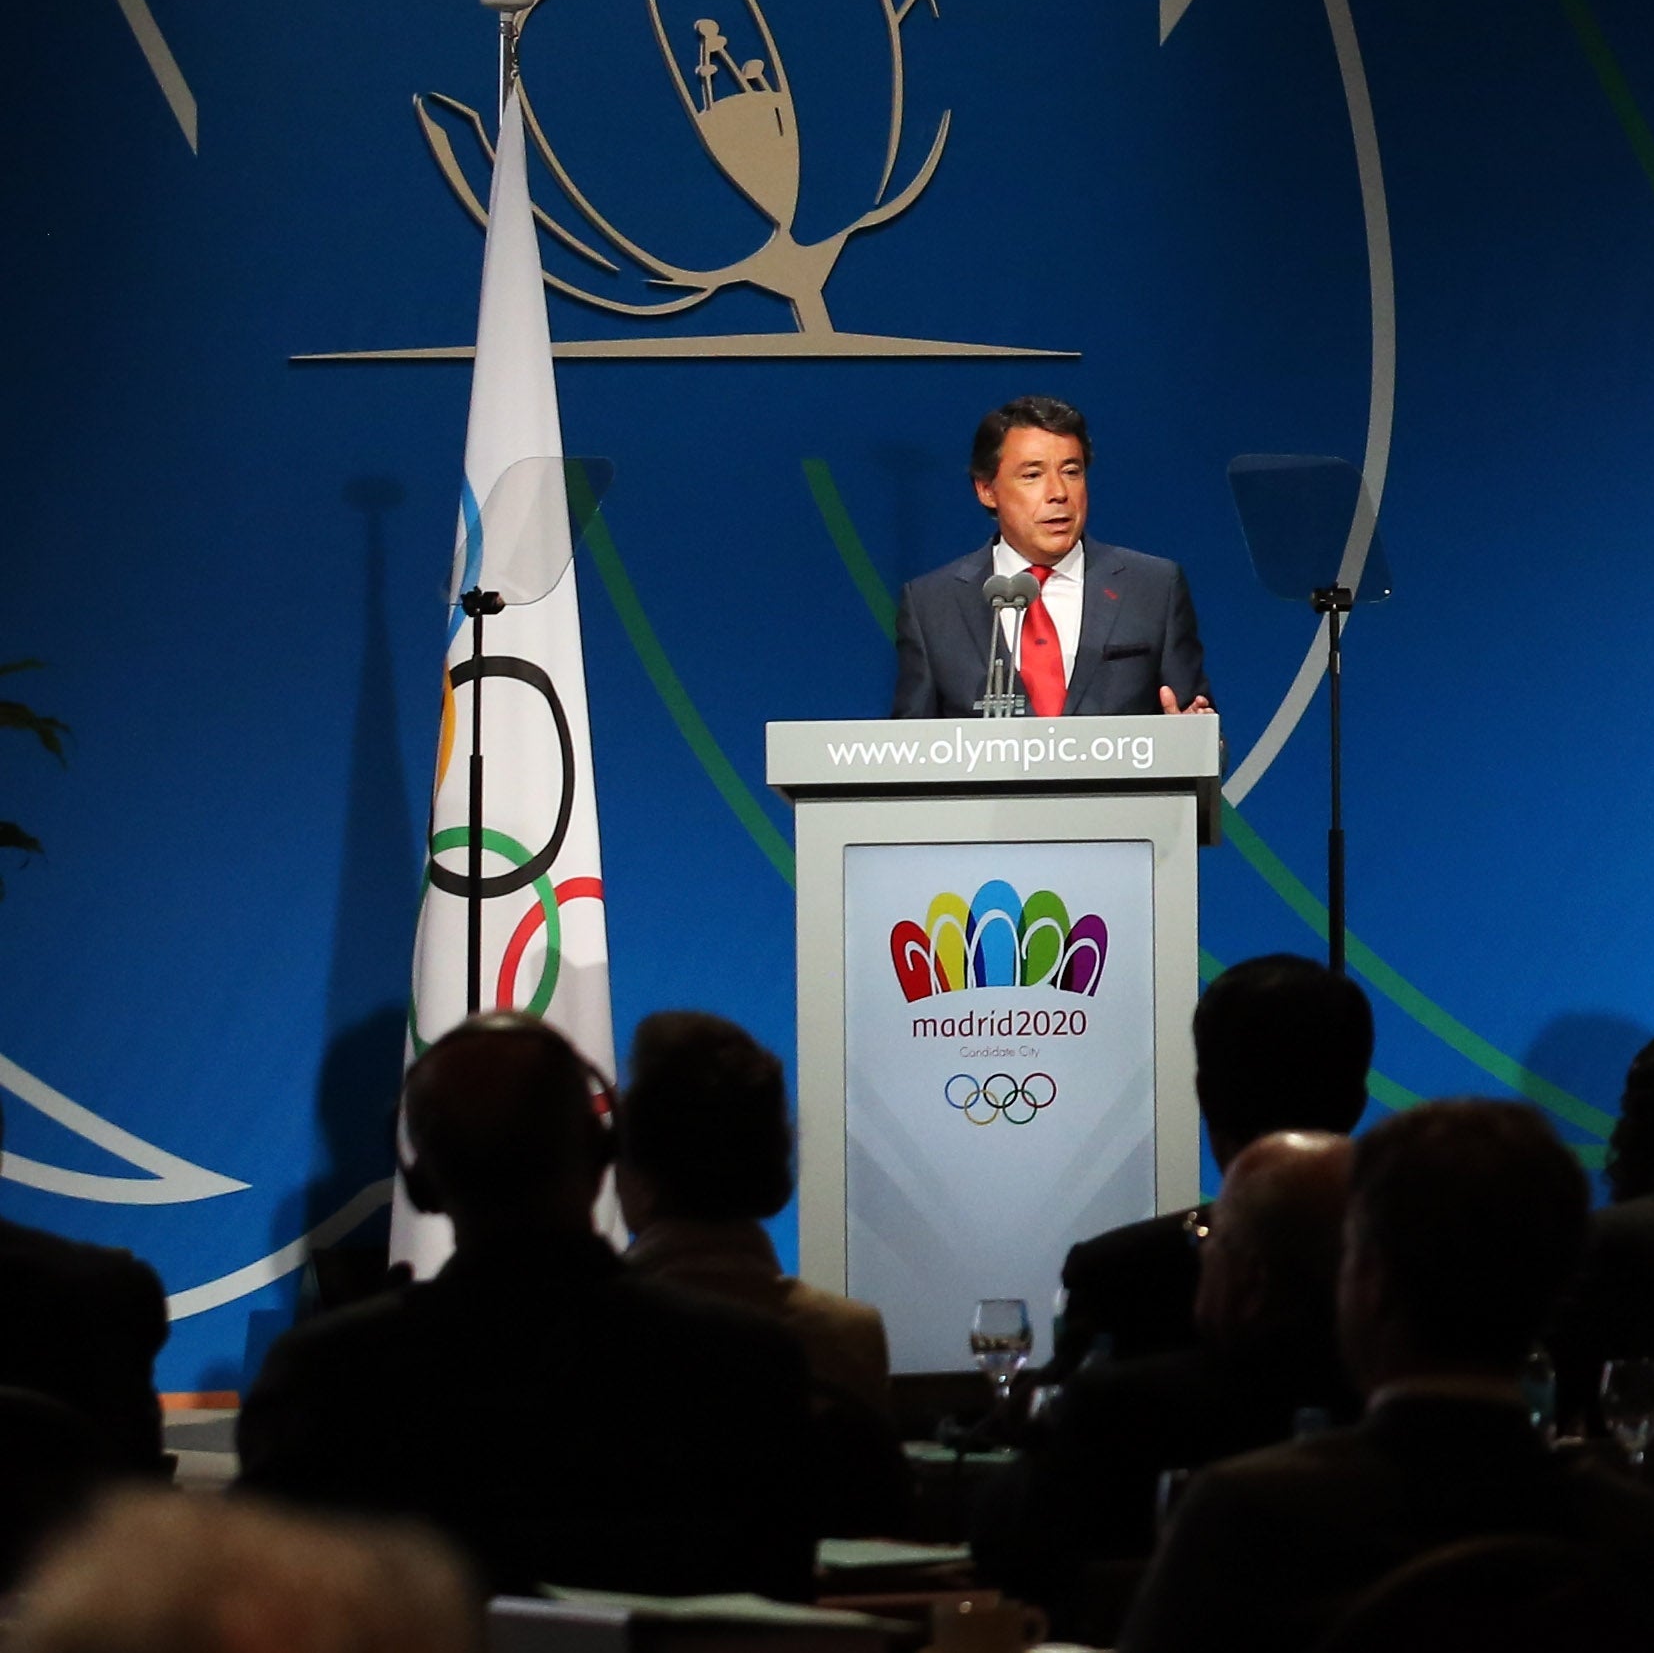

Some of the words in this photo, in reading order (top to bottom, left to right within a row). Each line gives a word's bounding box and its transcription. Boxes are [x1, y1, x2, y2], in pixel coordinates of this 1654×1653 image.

[827, 727, 1153, 772] www.olympic.org
[912, 1009, 1087, 1037] madrid2020
[959, 1046, 1016, 1058] Candidate
[1019, 1045, 1040, 1058] City
